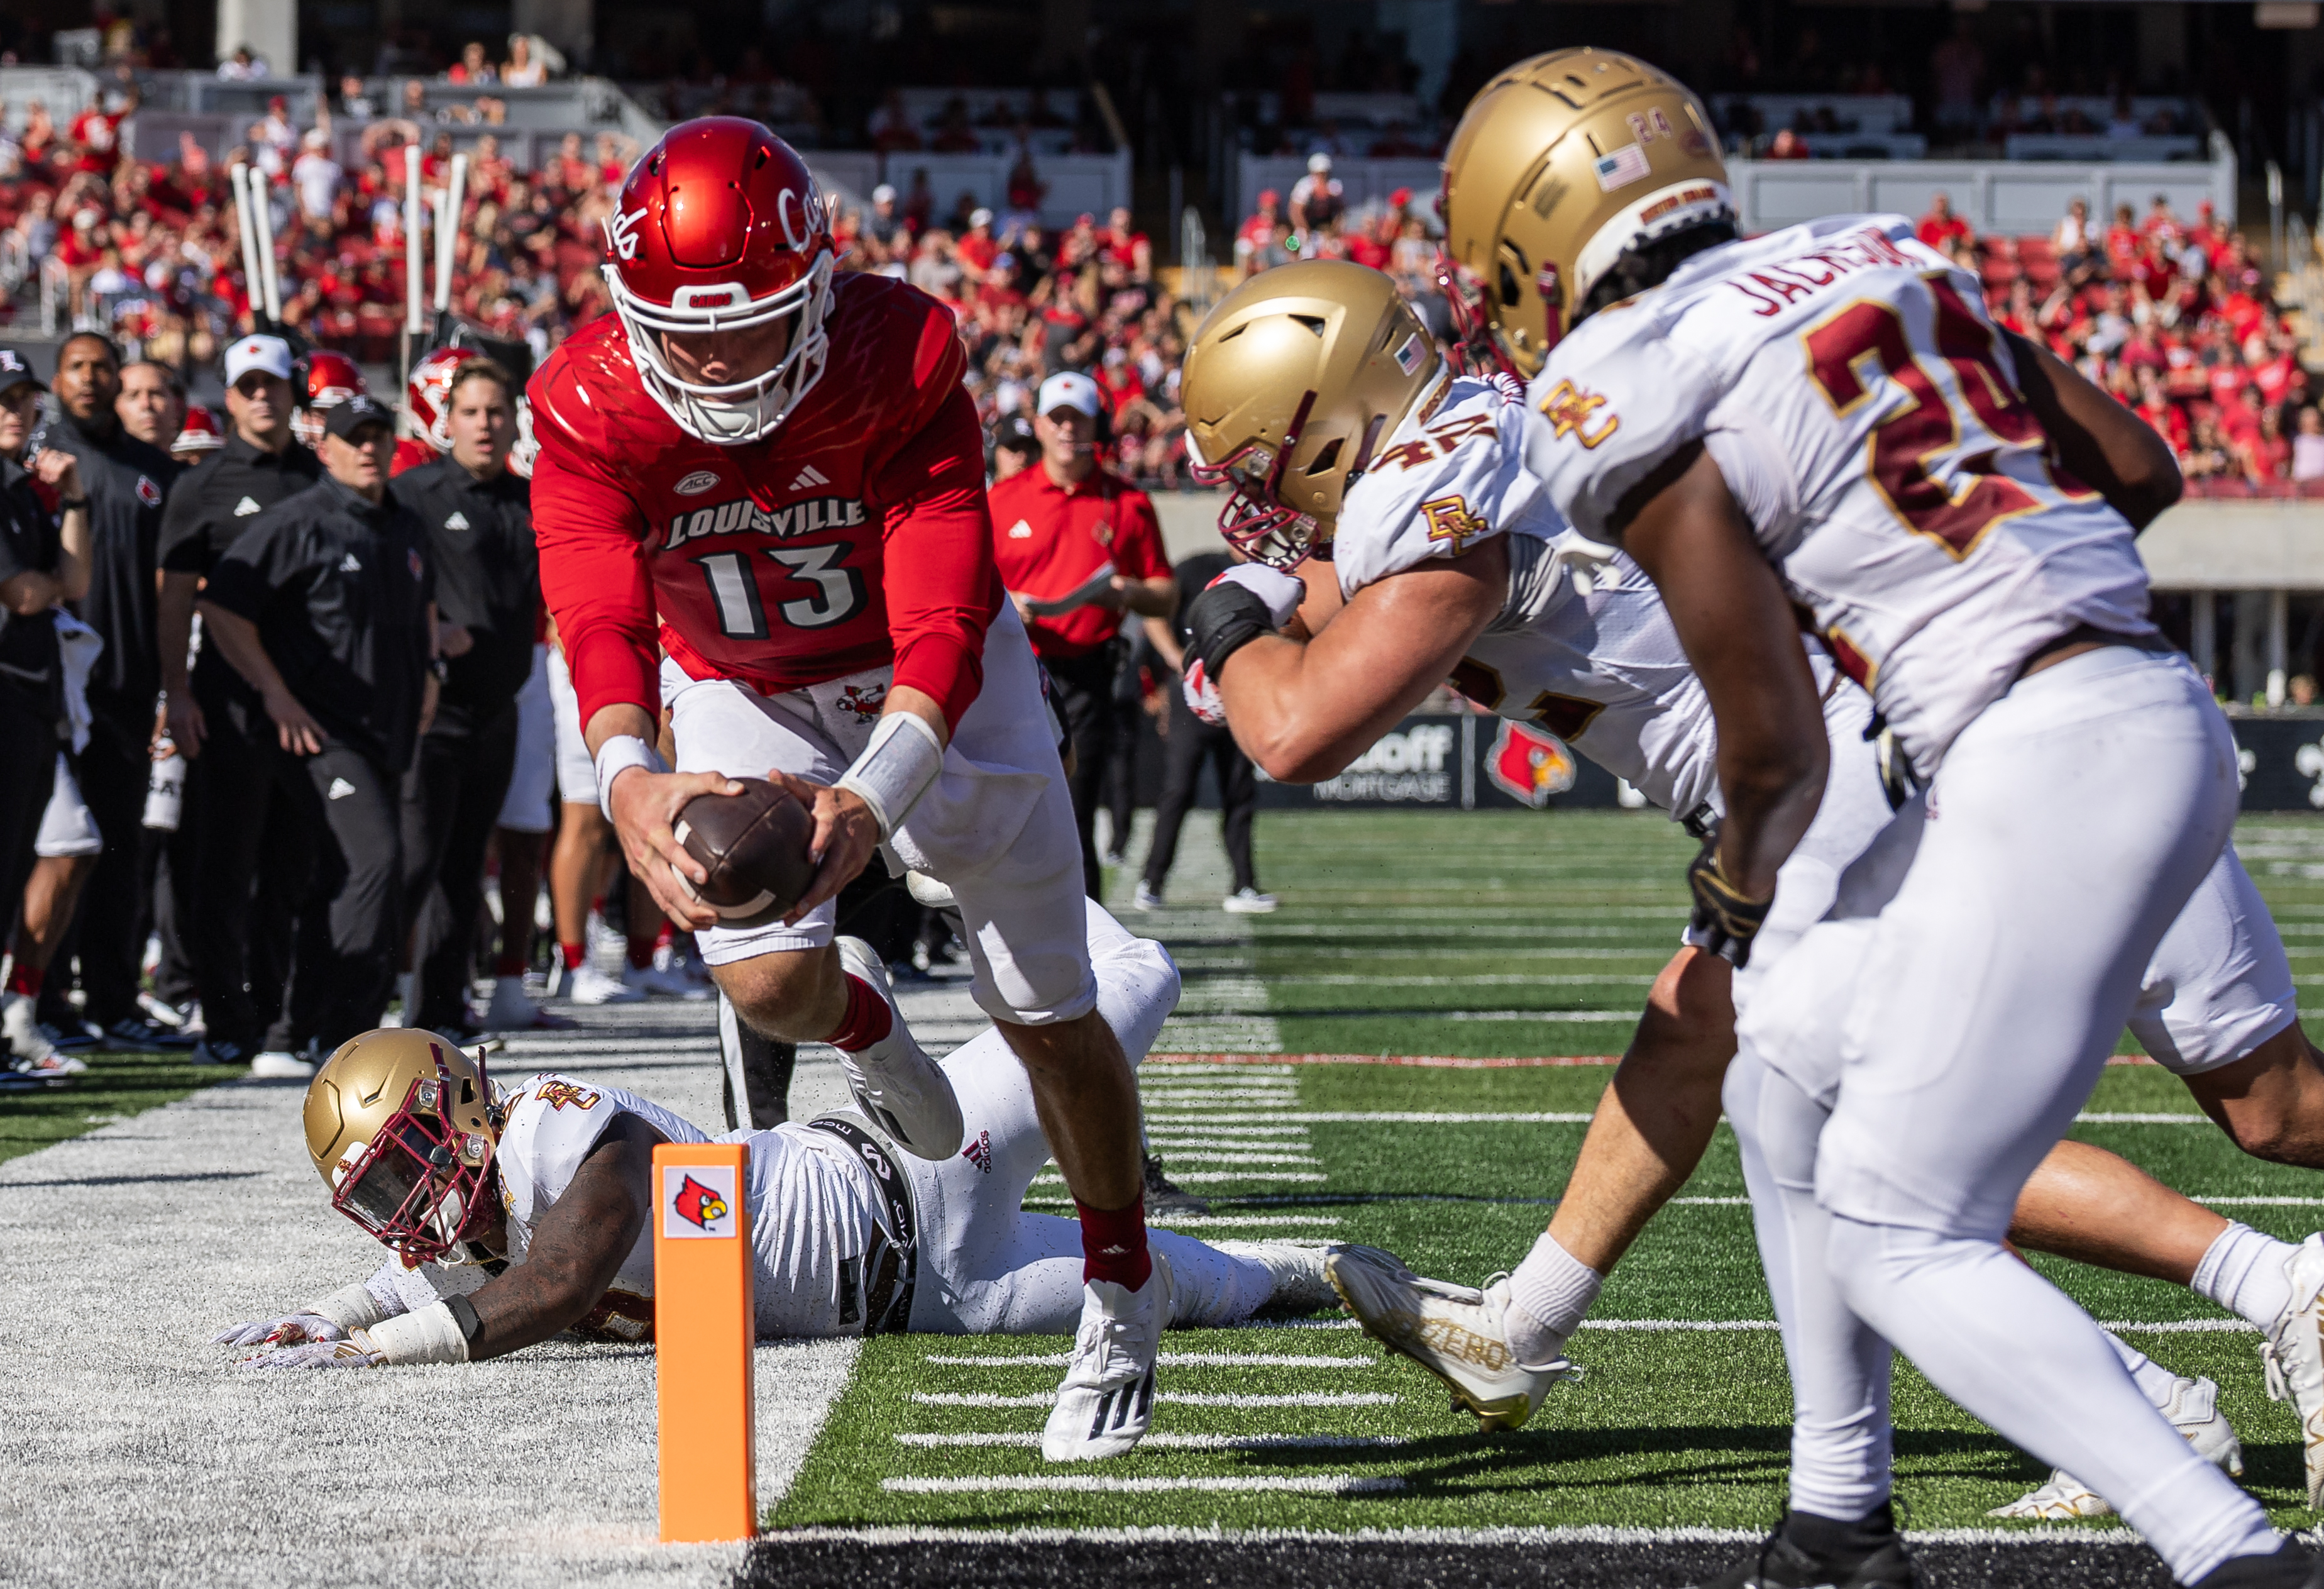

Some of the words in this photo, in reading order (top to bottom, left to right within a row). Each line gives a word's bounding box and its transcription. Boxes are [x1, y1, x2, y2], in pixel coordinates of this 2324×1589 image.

[1626, 106, 1674, 146] 24
[690, 293, 732, 308] CARDS
[1800, 269, 2105, 556] 24
[1365, 412, 1499, 473] 42
[682, 475, 711, 489] ACC
[660, 497, 869, 551] LOUISVILLE
[690, 541, 870, 640] 13
[980, 1129, 992, 1174] adidas
